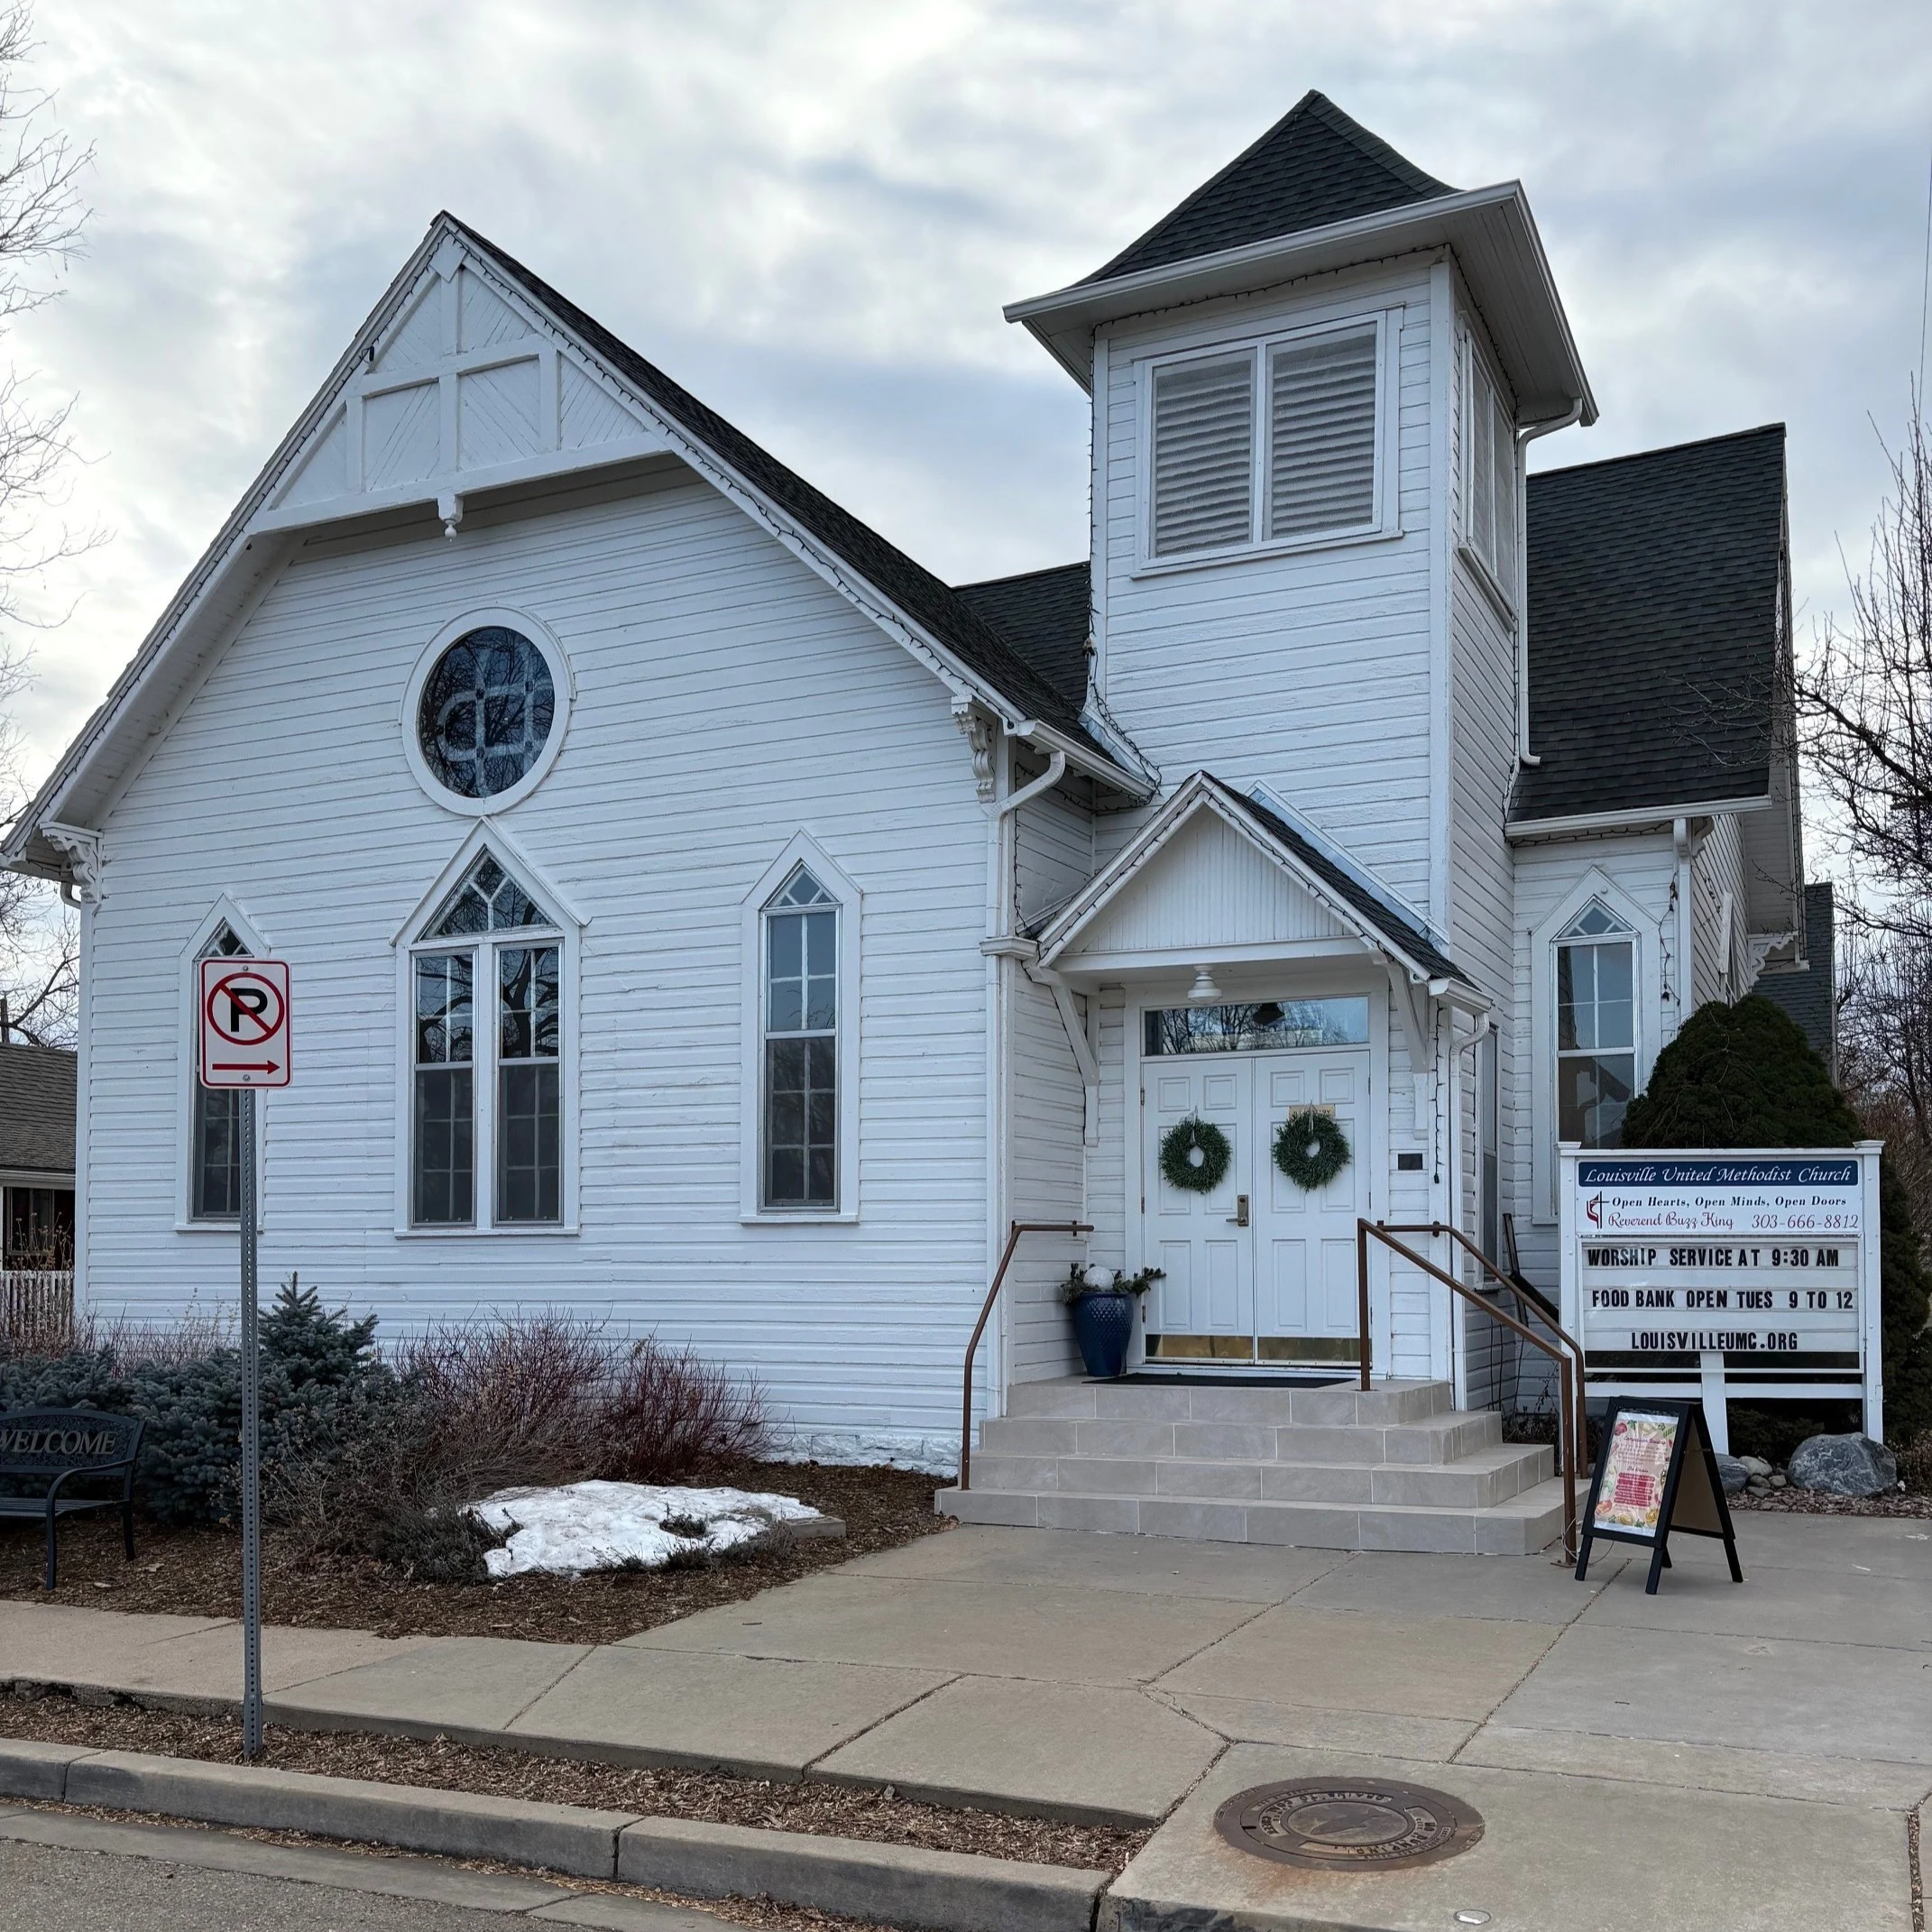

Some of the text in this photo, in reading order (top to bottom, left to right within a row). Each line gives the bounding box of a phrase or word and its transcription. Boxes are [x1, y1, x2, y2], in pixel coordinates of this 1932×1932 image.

[230, 988, 268, 1033] P
[1584, 1165, 1852, 1182] Louisville United Methodist Church
[1612, 1195, 1846, 1209] Open Hearts, Open Minds, Open Doors
[1607, 1210, 1859, 1230] Reverend Buzz King 303-666-8812
[1587, 1247, 1839, 1266] WORSHIP SERVICE AT 9:30 AM
[1592, 1289, 1854, 1309] FOOD BANK OPEN TUES 9 TO 12
[1631, 1331, 1798, 1350] LOUISVILLEUMC.ORG
